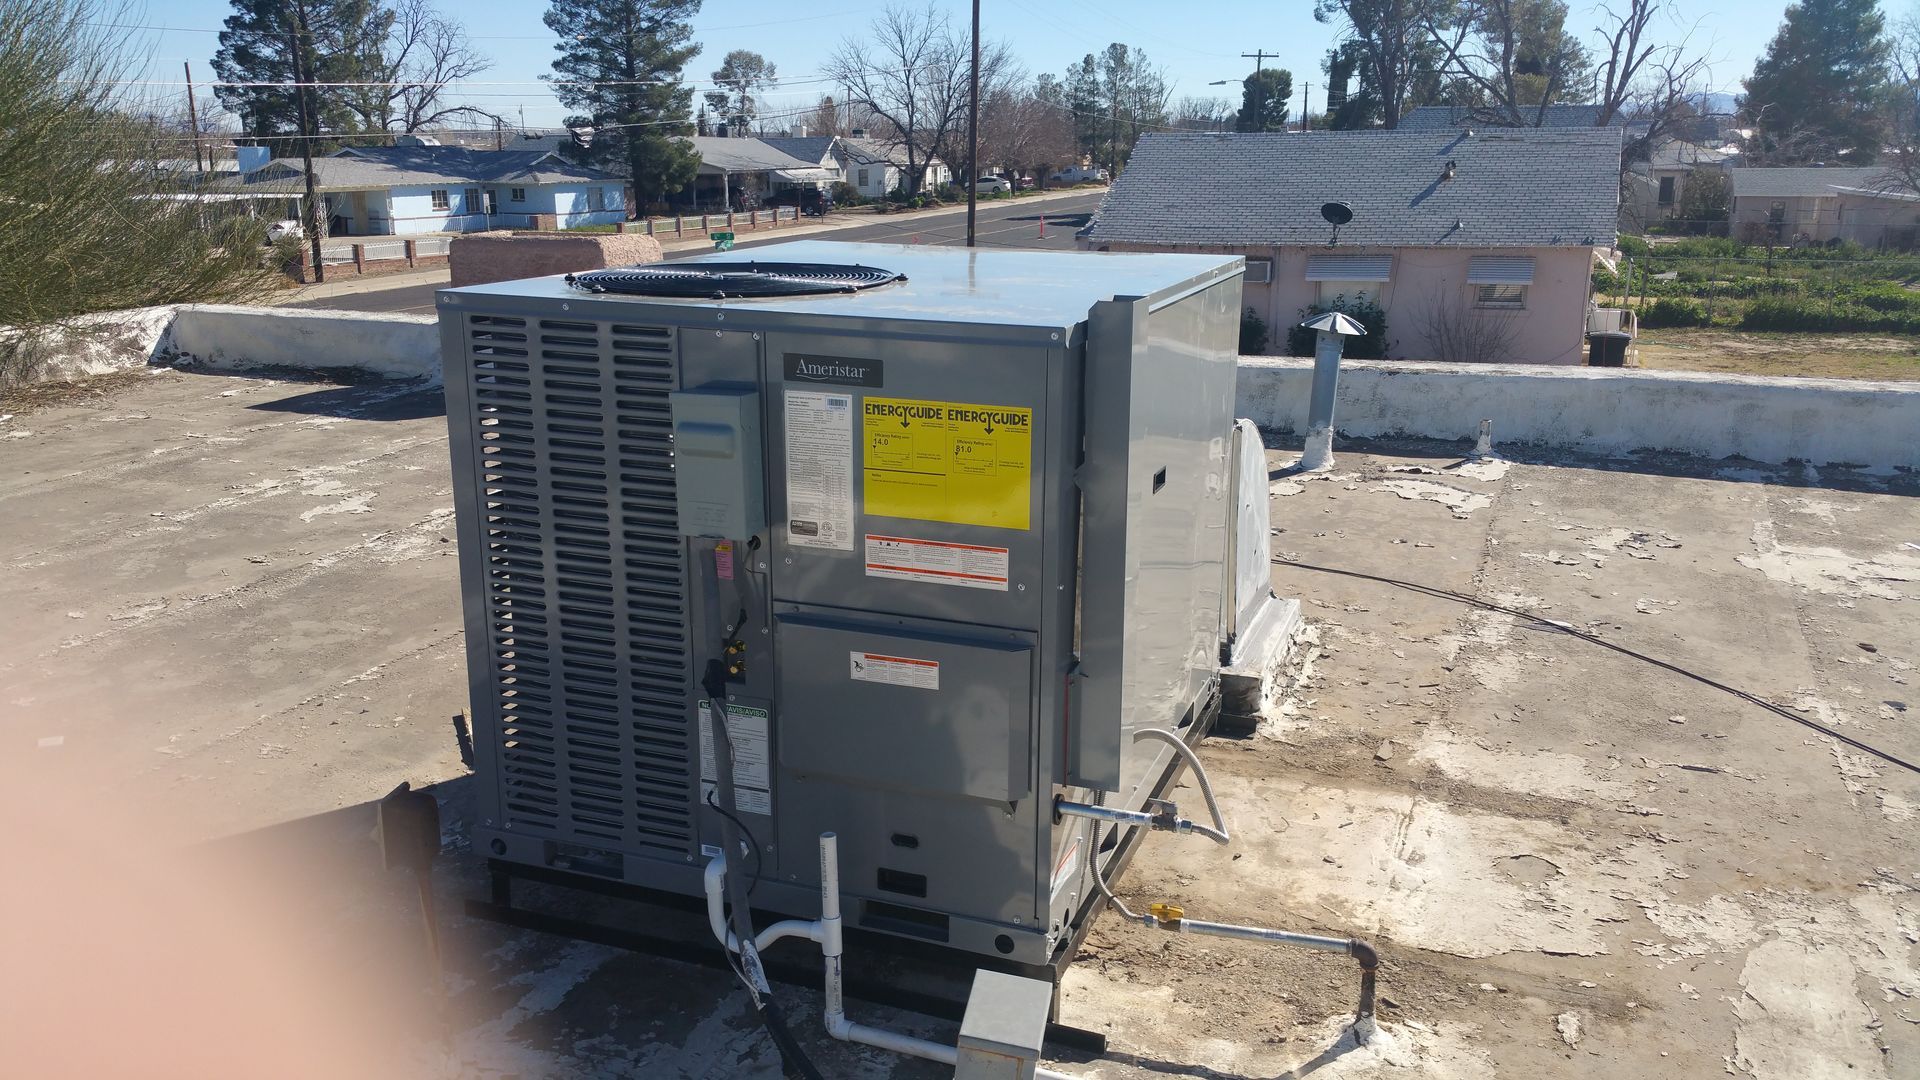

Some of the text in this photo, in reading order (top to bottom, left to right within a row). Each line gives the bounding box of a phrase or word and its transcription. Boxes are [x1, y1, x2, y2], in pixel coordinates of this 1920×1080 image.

[796, 358, 866, 378] Ameristar
[865, 403, 943, 420] ENERGYGUIDE
[947, 409, 1029, 426] ENERGYGUIDE
